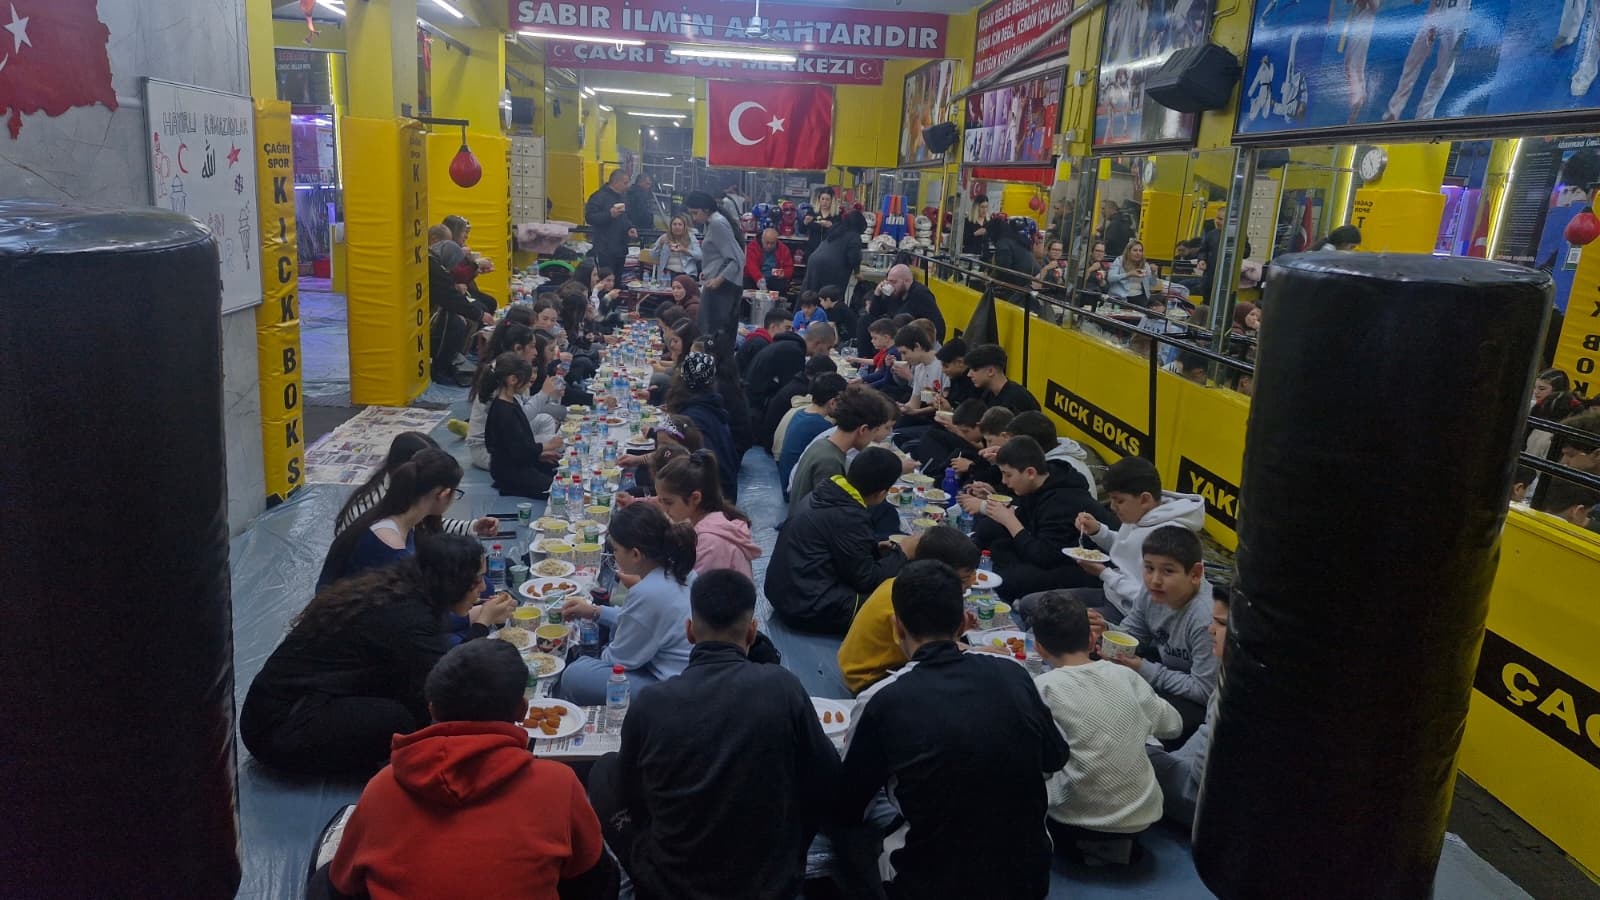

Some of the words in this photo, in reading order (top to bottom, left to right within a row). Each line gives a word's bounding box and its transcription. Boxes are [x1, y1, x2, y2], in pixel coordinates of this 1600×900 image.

[518, 2, 611, 29] SABIR
[622, 1, 713, 36] İLMİN
[263, 143, 290, 156] ÇAĞRI
[267, 157, 290, 169] SPOR
[272, 175, 295, 321] KICK
[412, 162, 423, 265] KICK
[415, 282, 425, 378] BOKS
[282, 346, 301, 485] BOKS
[1053, 391, 1089, 425] KICK
[1092, 415, 1141, 457] BOKS
